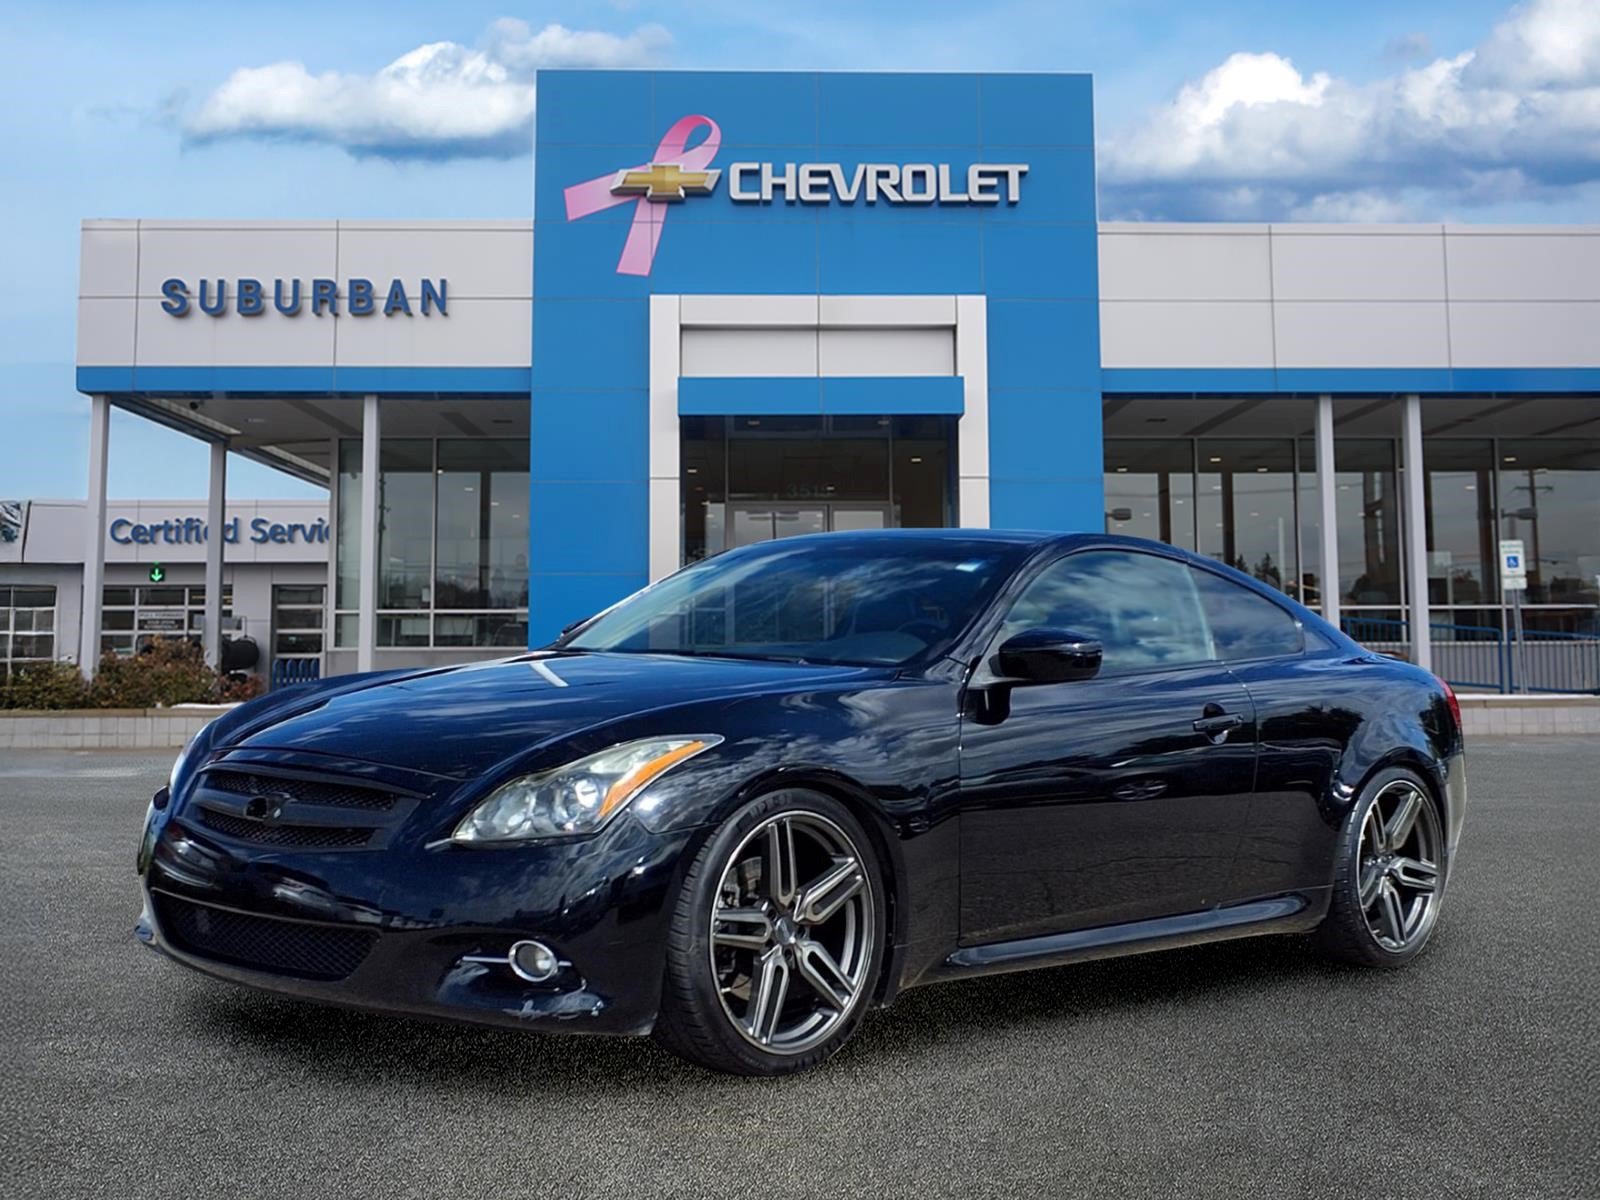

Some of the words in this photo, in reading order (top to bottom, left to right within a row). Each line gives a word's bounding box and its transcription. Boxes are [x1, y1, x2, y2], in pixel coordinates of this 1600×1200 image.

[729, 162, 1029, 205] CHEVROLET
[161, 278, 449, 317] SUBURBAN
[110, 518, 240, 545] Certifid
